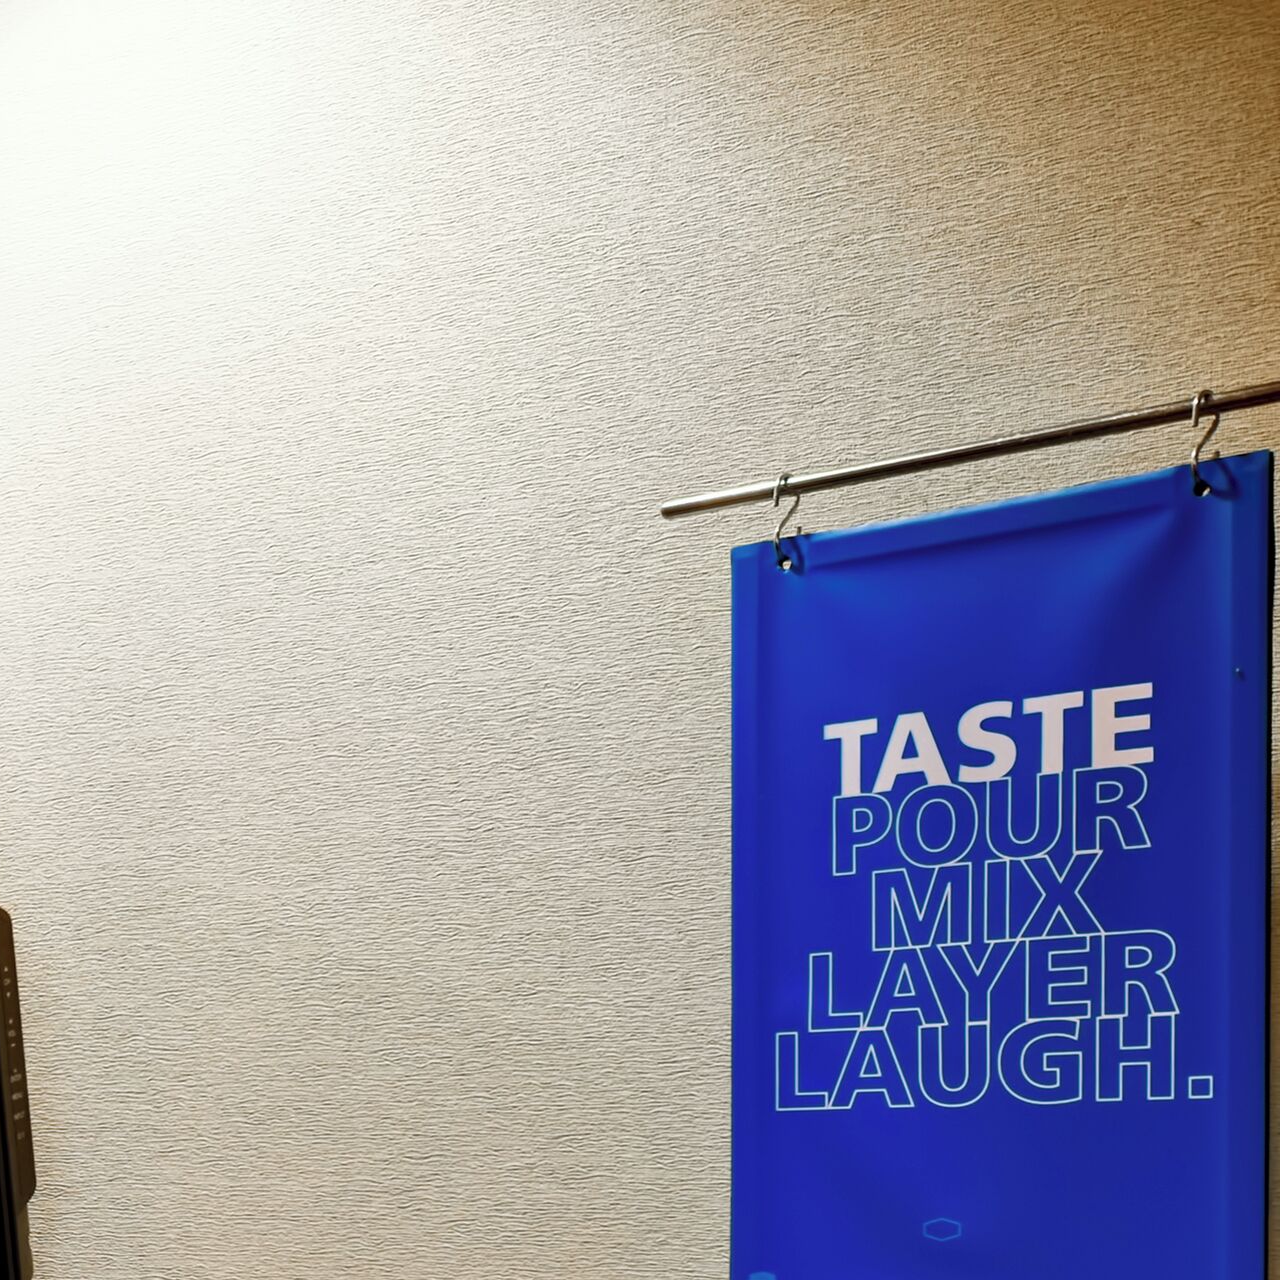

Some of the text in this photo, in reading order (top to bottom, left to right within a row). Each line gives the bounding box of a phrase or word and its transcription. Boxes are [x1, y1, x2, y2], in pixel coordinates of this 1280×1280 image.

[823, 682, 1154, 798] TASTE
[832, 765, 1151, 876] POUR
[872, 849, 1105, 951] MIX
[808, 929, 1180, 1032] LAYER
[775, 1013, 1214, 1111] LAUGH.
